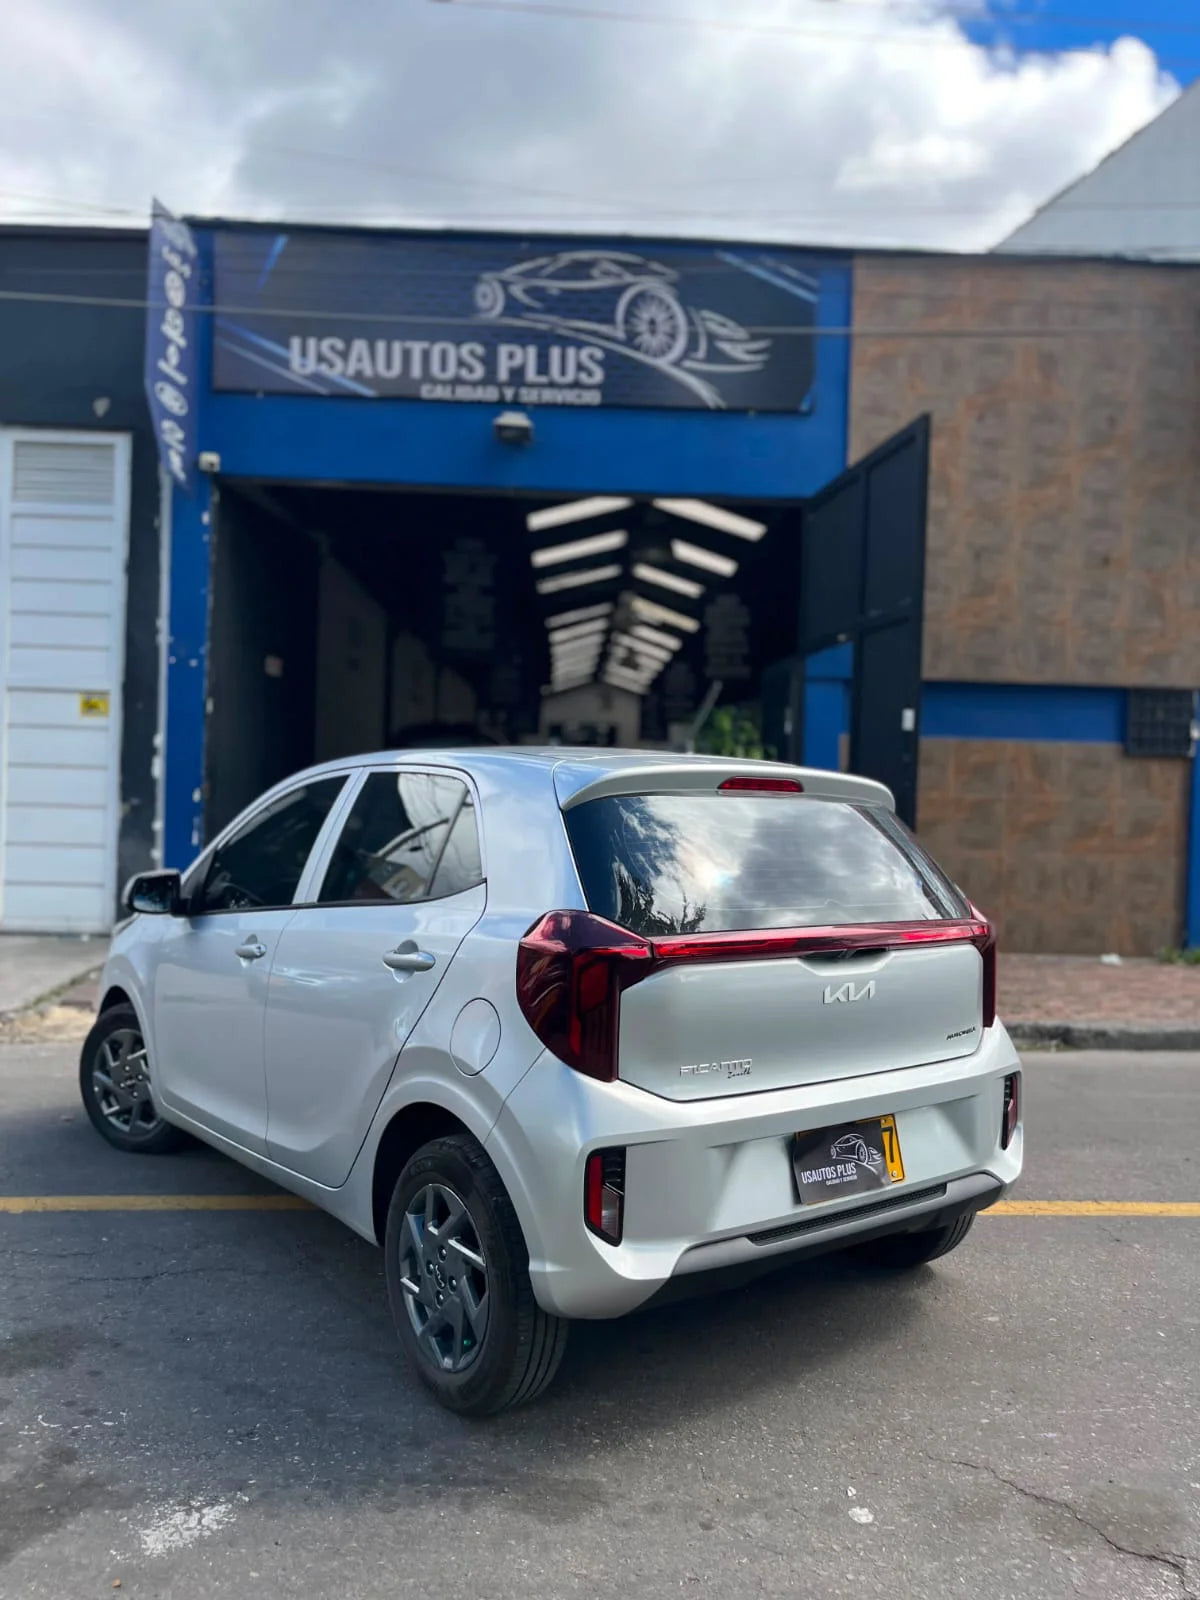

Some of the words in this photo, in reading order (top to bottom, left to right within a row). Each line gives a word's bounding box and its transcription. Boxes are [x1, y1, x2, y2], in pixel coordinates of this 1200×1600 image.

[289, 335, 486, 382] USAUTOS
[497, 343, 605, 386] PLUS
[503, 386, 516, 403] Y
[822, 980, 876, 1004] KIA
[800, 1166, 836, 1184] USAUTOS
[836, 1162, 857, 1177] PLUS
